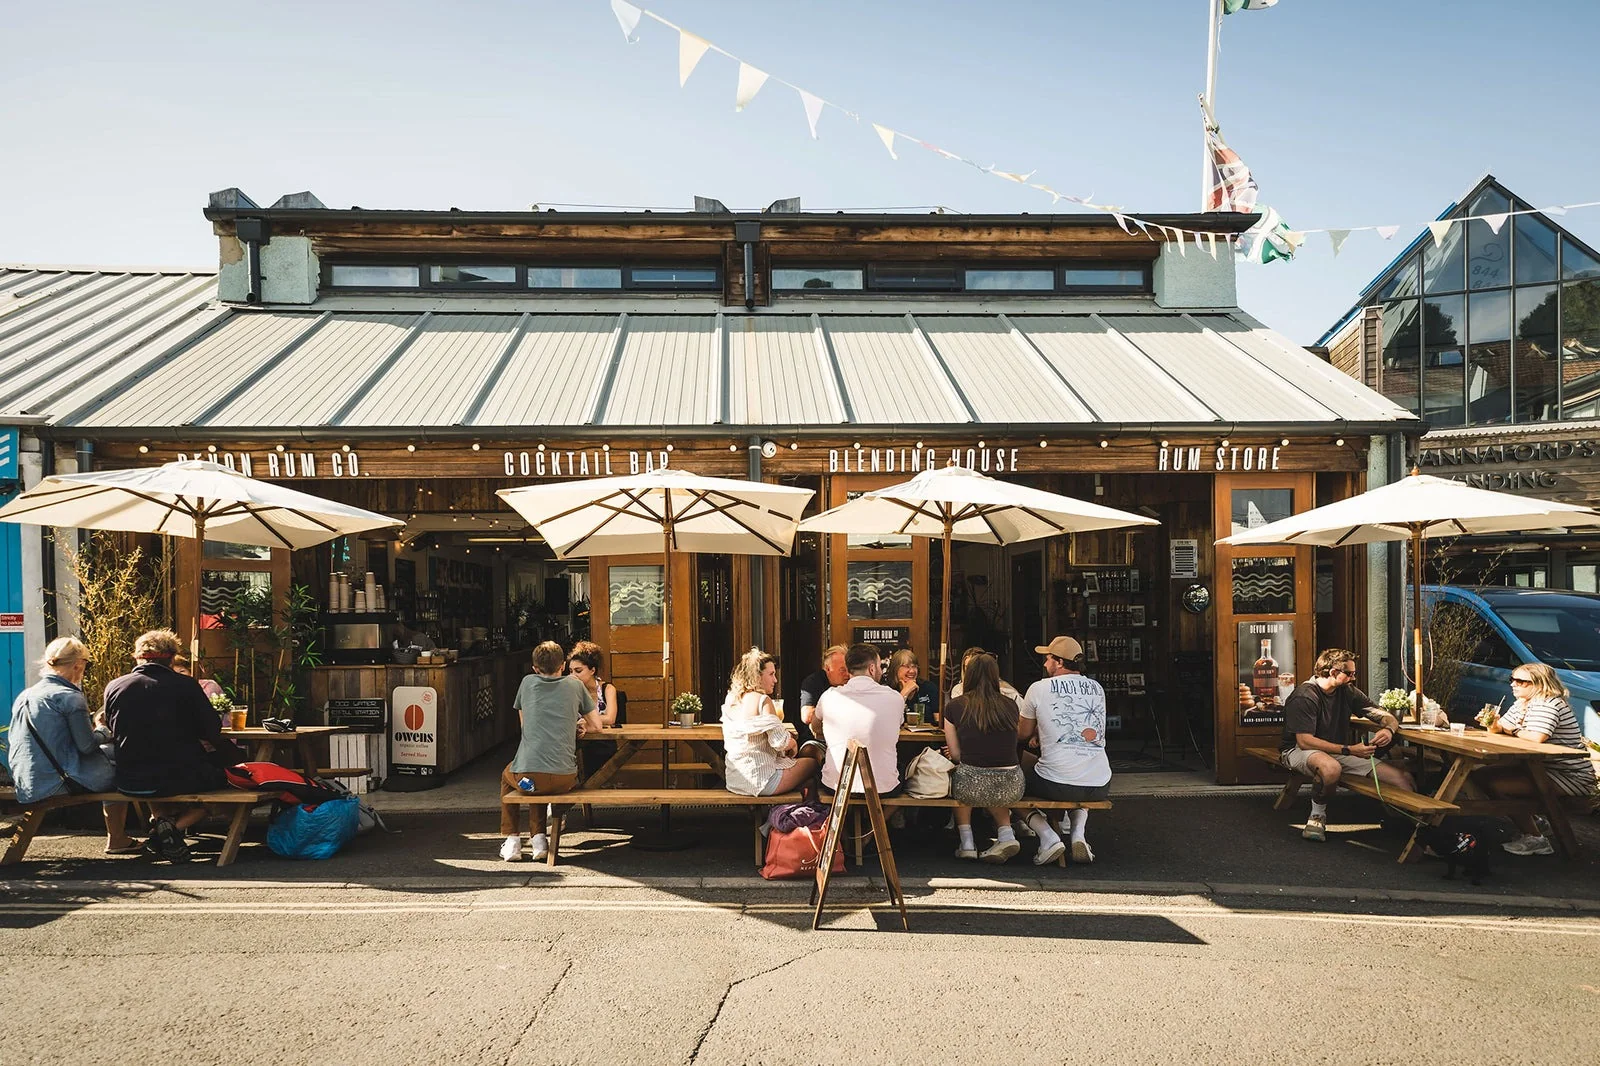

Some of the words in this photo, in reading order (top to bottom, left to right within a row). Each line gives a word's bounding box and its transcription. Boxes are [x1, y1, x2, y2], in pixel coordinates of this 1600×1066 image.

[268, 453, 316, 477] RUM
[332, 452, 370, 477] CO.
[504, 451, 613, 476] COCKTAIL
[630, 451, 669, 475] BAR
[829, 449, 936, 473] BLENDING
[952, 448, 1019, 472] HOUSE
[1158, 448, 1201, 471] RUM
[1215, 447, 1281, 471] STORE
[864, 630, 880, 639] DEVON
[881, 630, 893, 639] RUM
[1249, 624, 1266, 634] DEVON
